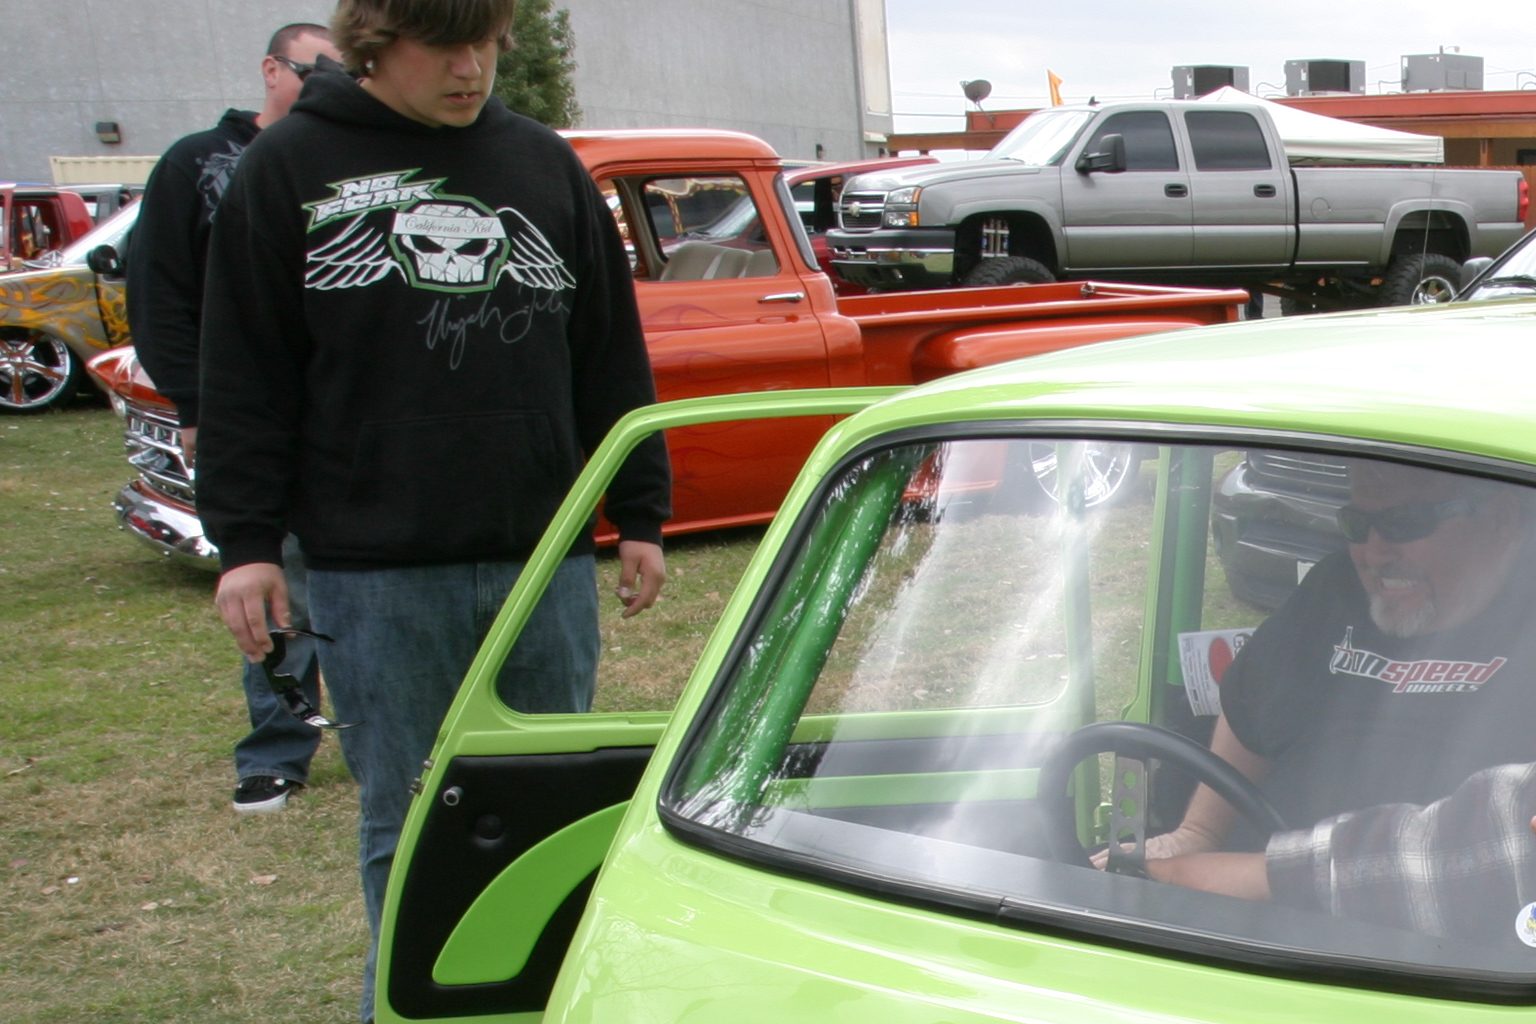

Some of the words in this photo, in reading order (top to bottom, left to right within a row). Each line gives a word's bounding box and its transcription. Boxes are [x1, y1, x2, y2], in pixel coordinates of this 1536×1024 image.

[340, 174, 400, 198] NO
[312, 183, 437, 223] FEAR
[402, 215, 461, 233] California
[463, 219, 493, 234] Kid
[1405, 682, 1479, 694] WHEELS
